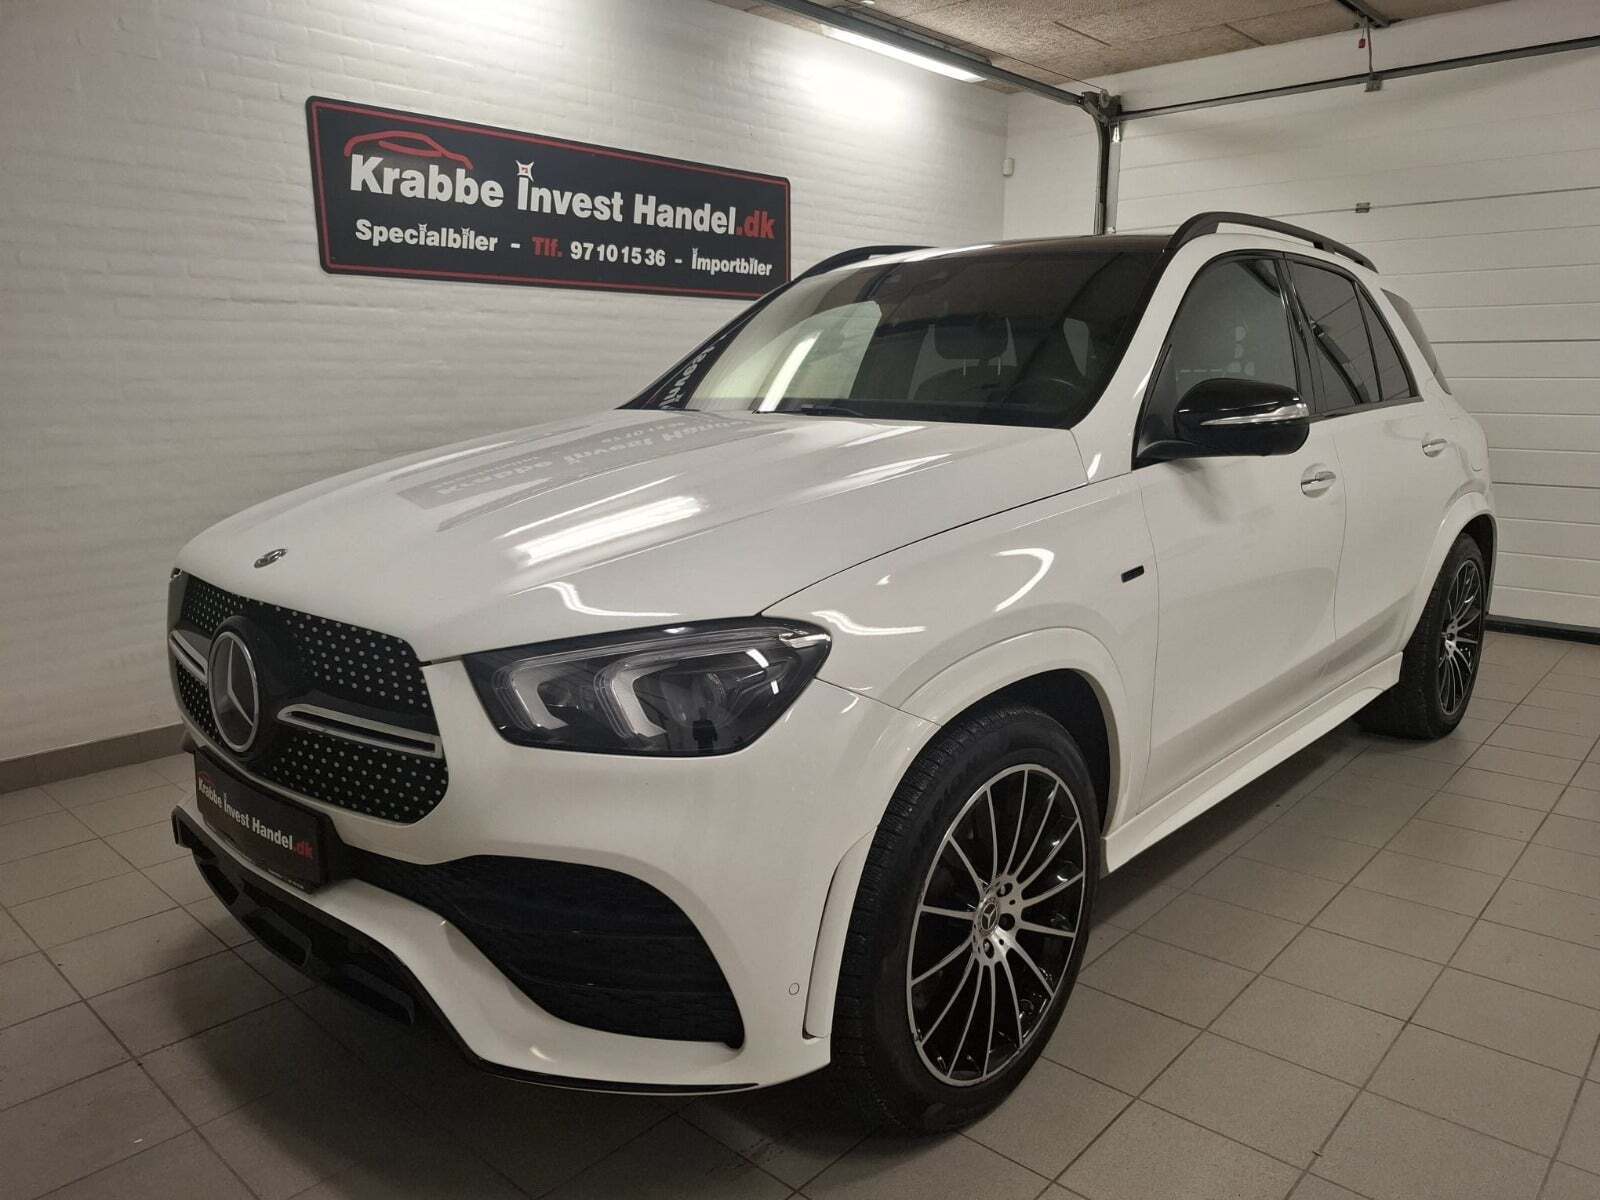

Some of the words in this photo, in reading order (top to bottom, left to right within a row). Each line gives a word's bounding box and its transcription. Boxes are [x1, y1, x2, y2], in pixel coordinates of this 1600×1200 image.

[351, 154, 504, 208] Krabbe
[516, 161, 624, 222] Invest
[633, 193, 776, 239] Handel.dk
[355, 218, 498, 251] Specialbiler
[532, 236, 563, 257] Tlf.
[691, 248, 773, 276] Importbiler
[223, 792, 250, 829] Invest
